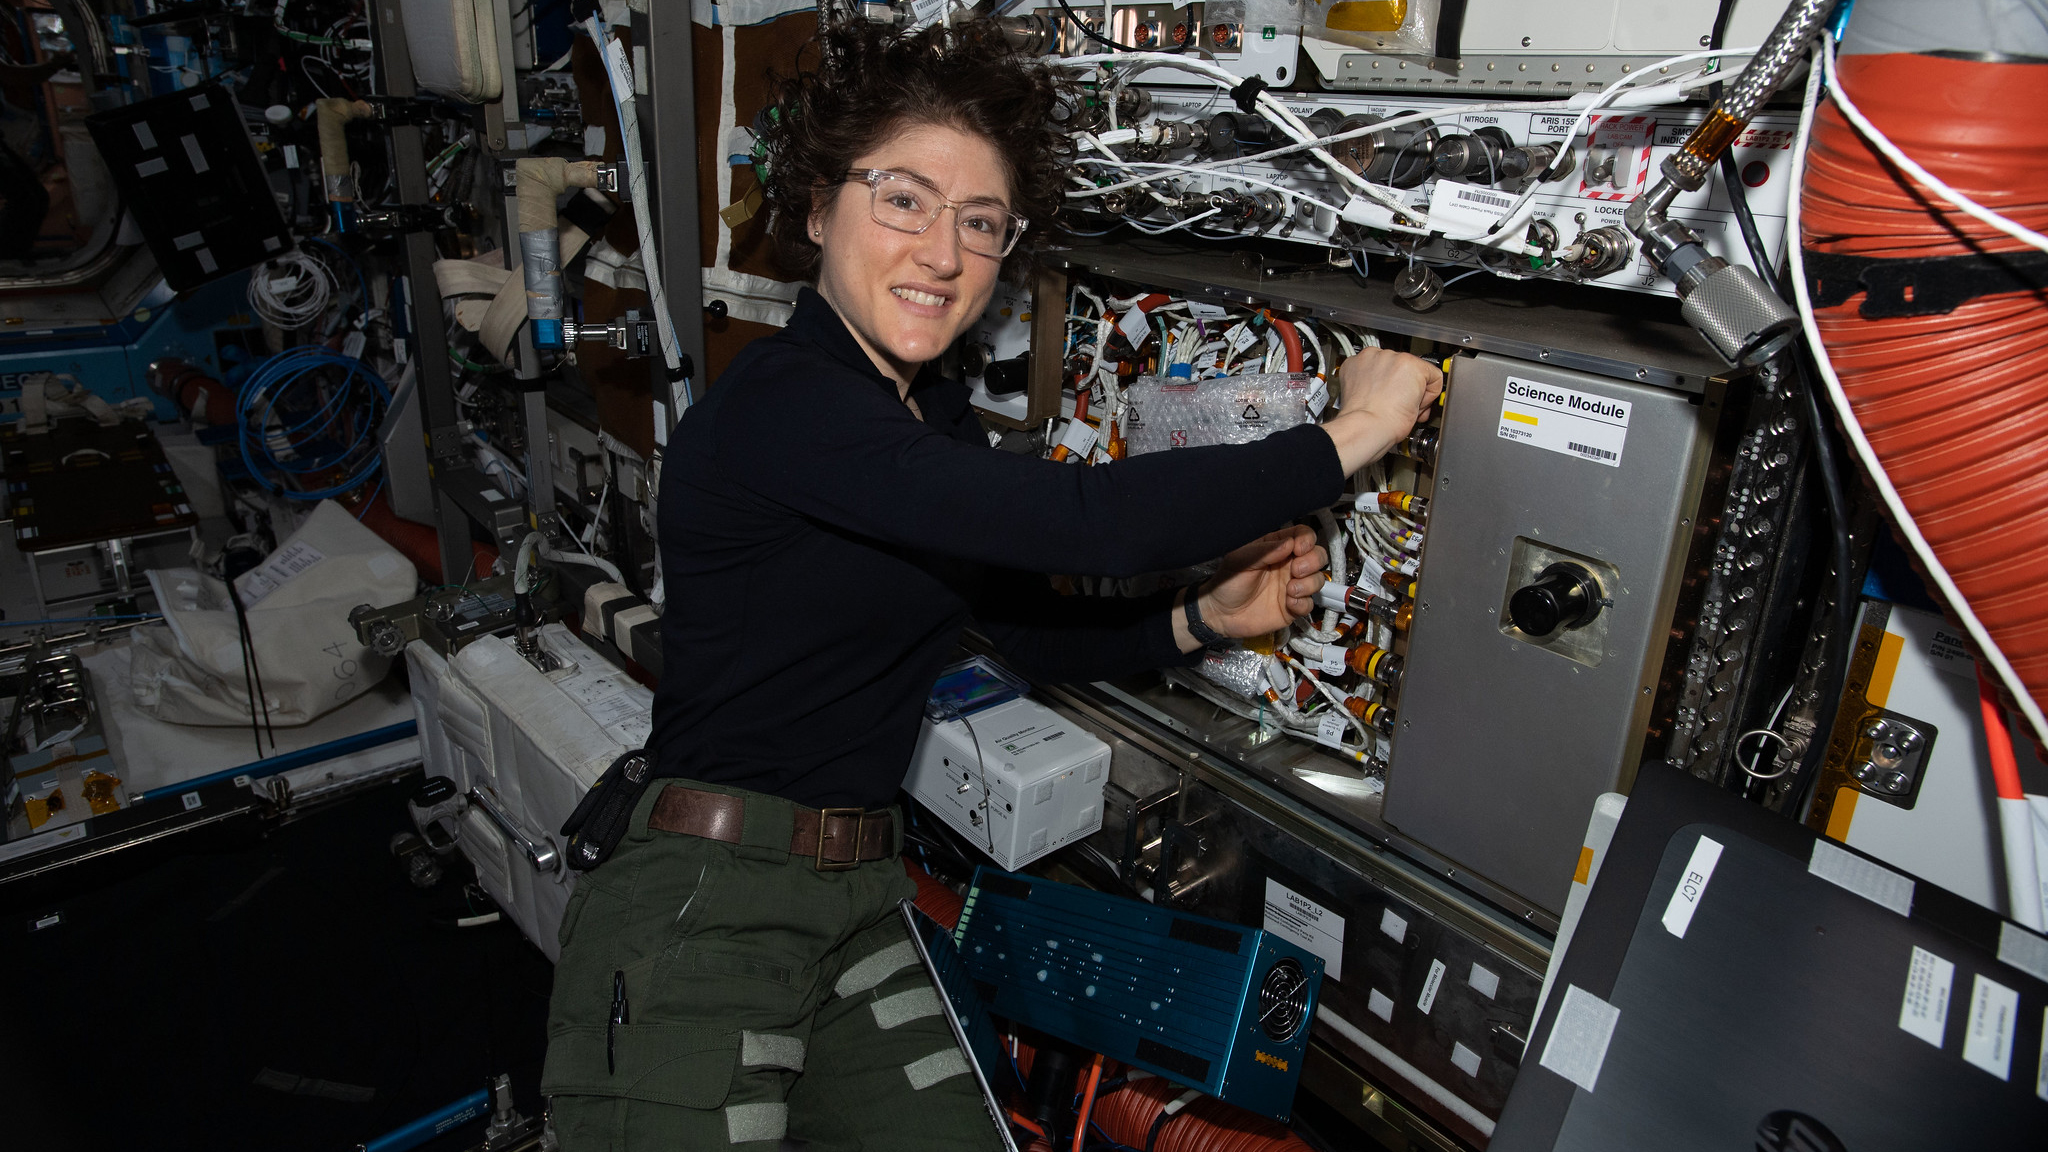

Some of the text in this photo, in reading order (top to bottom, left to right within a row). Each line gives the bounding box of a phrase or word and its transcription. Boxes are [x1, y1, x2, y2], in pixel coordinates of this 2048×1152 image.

[1464, 116, 1499, 124] NITROGEN
[1540, 116, 1560, 125] ARIS
[1547, 126, 1569, 134] PORT
[1600, 122, 1644, 132] RACK POWER
[1672, 128, 1692, 136] SMO
[1594, 206, 1624, 216] LOCKE
[1448, 250, 1460, 260] G2
[1642, 278, 1654, 287] J2
[1508, 382, 1624, 418] Science Module
[1018, 726, 1035, 735] Monitor
[1681, 871, 1704, 904] ELC7
[1286, 892, 1323, 917] LAB1P2_L2
[1428, 975, 1437, 992] Molecular
